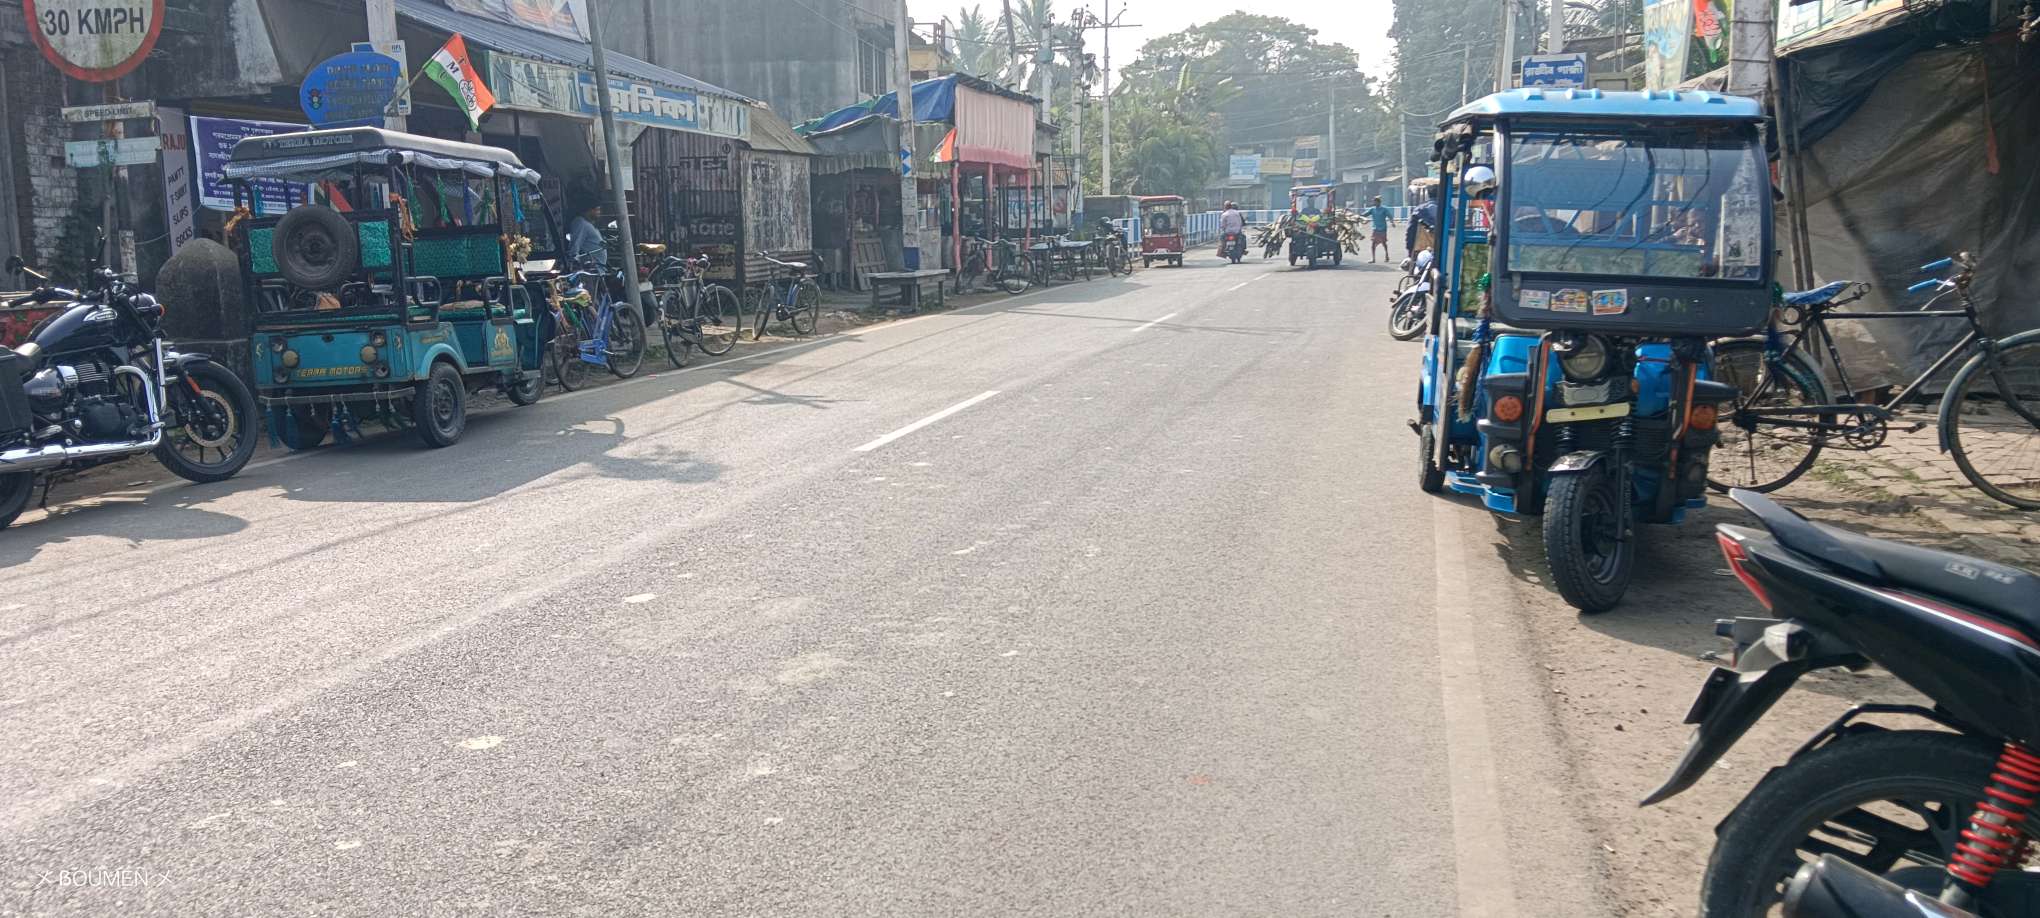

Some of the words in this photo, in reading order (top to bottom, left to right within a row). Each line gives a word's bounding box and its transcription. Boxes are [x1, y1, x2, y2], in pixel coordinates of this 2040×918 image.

[44, 8, 70, 36] 30
[77, 6, 145, 35] KMPH
[84, 107, 112, 118] SPEED
[162, 133, 186, 151] RAJU
[175, 225, 194, 248] SOCKS
